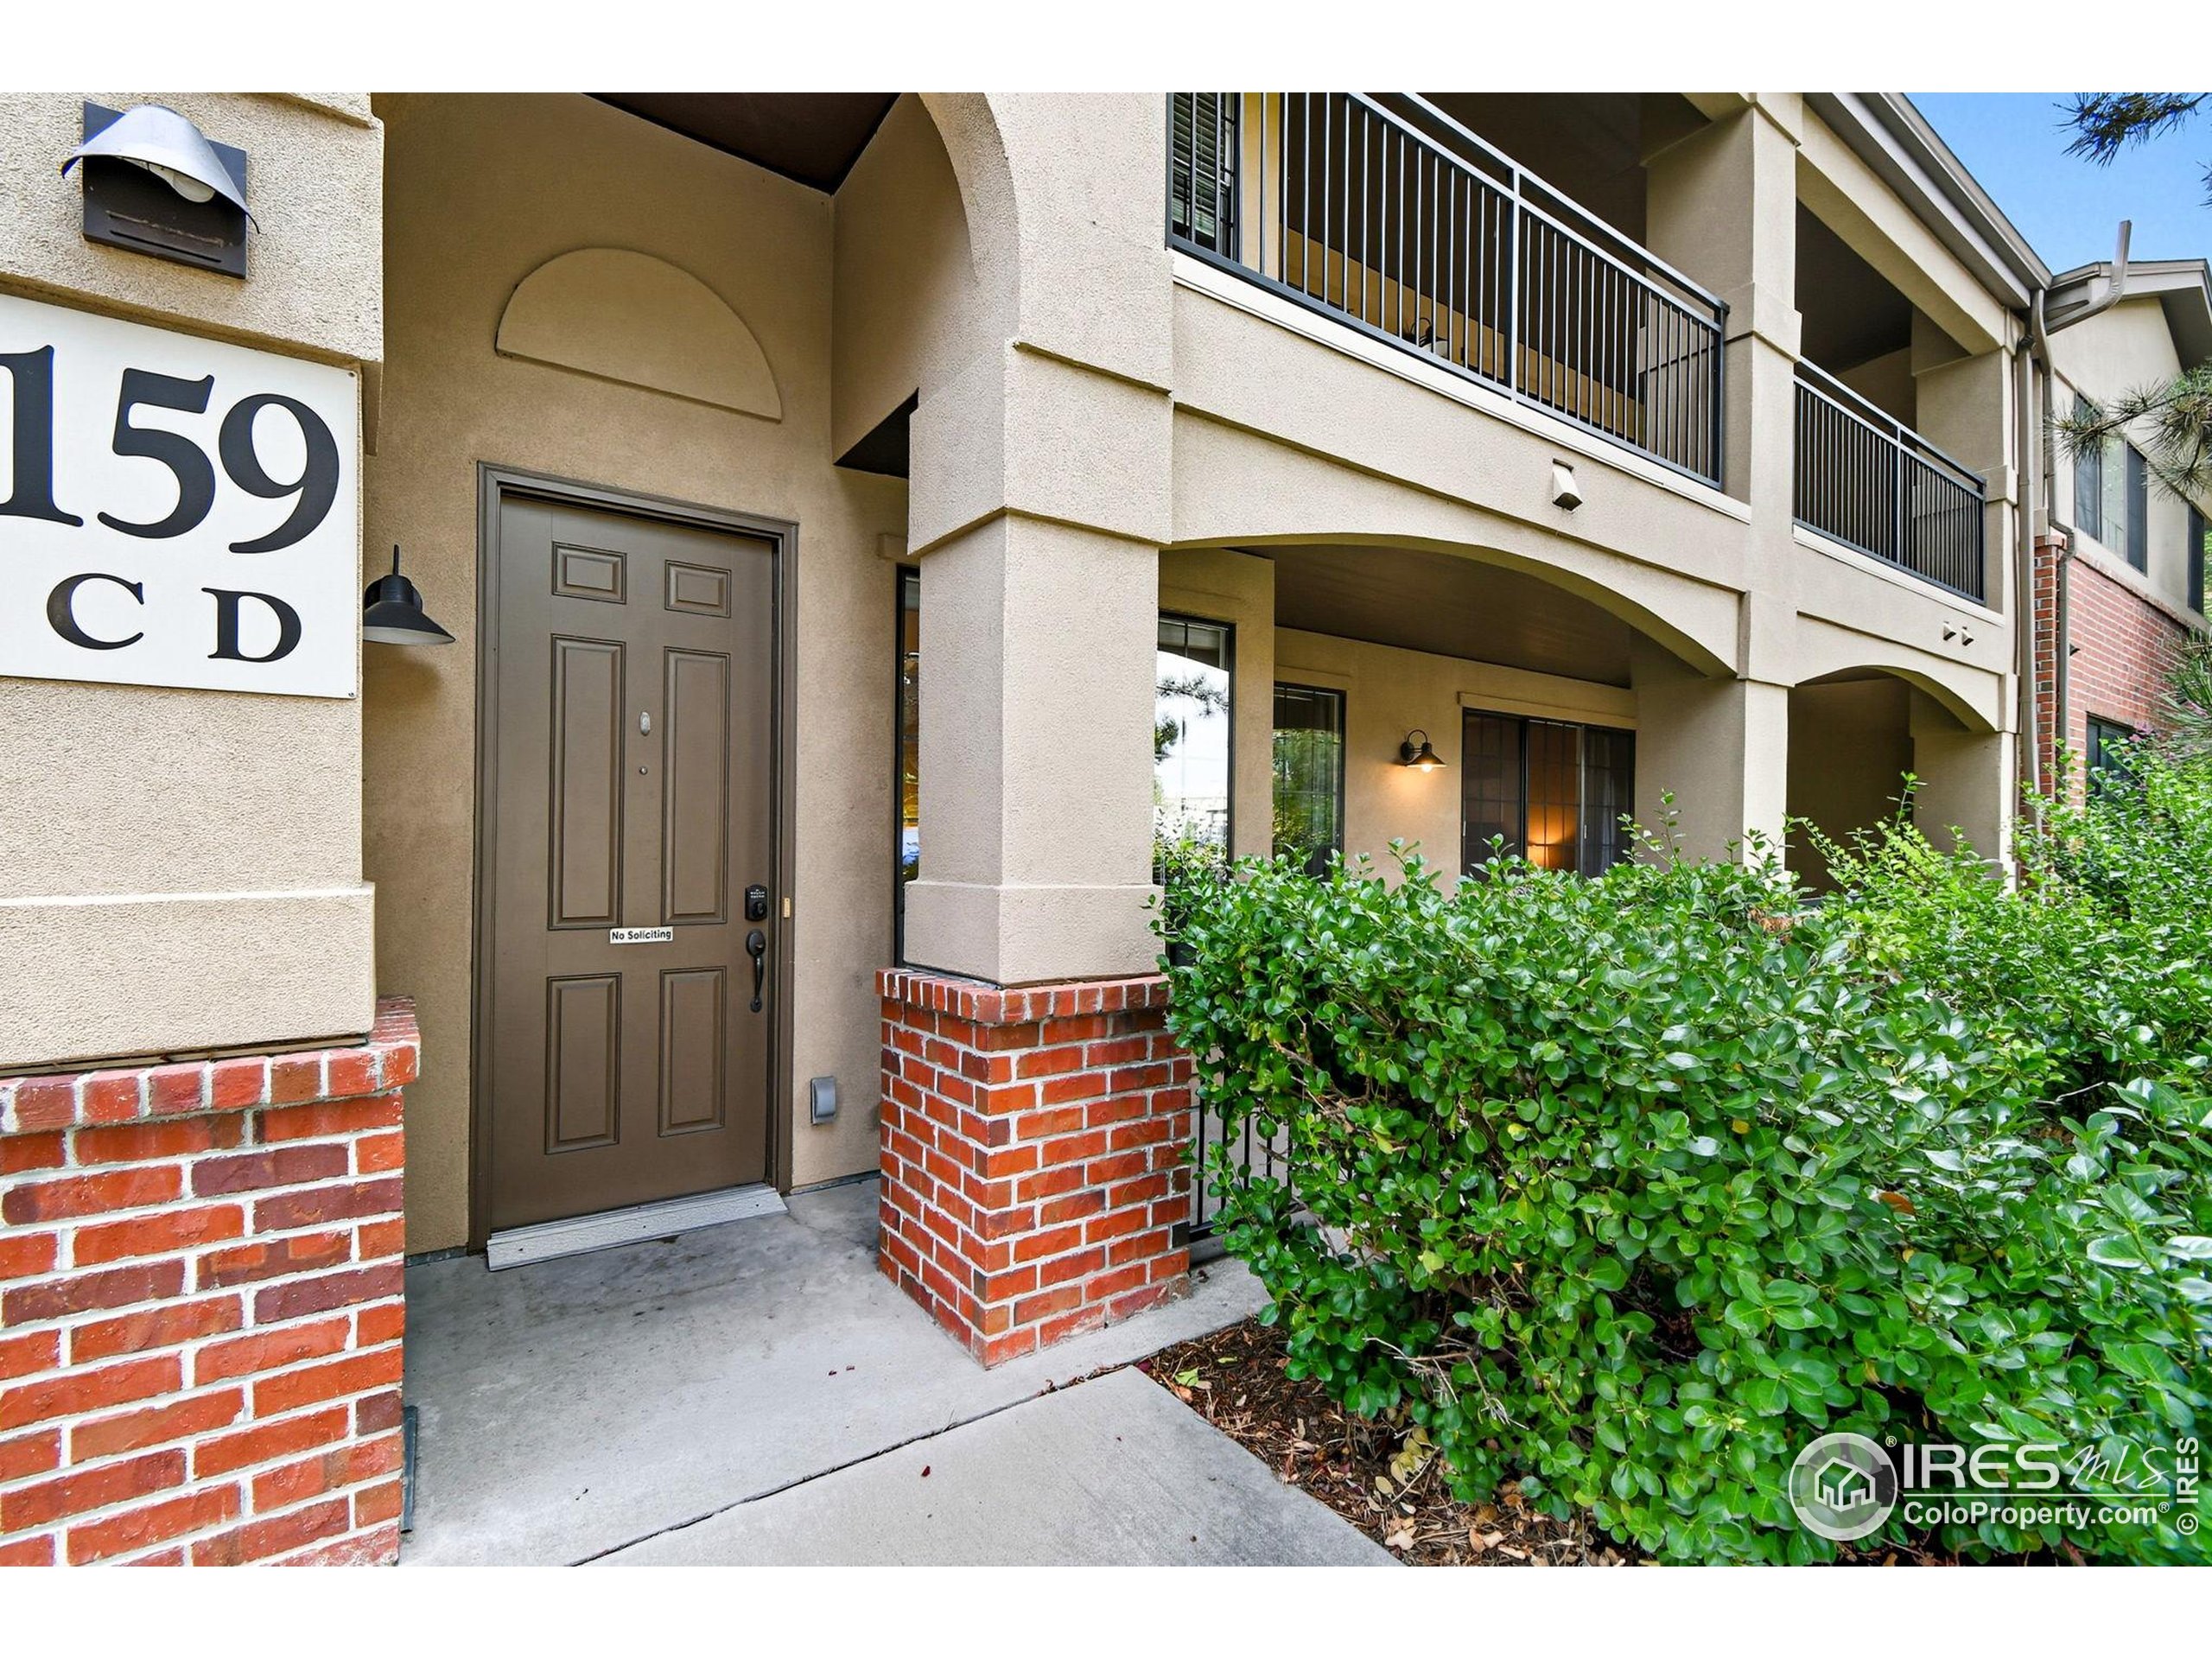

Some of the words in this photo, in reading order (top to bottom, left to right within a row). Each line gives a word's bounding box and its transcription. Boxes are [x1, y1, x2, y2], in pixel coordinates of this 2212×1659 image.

[0, 344, 340, 554] 159
[46, 572, 144, 650] C
[201, 588, 302, 663] D
[612, 931, 625, 940] No
[627, 930, 671, 940] Soliciting
